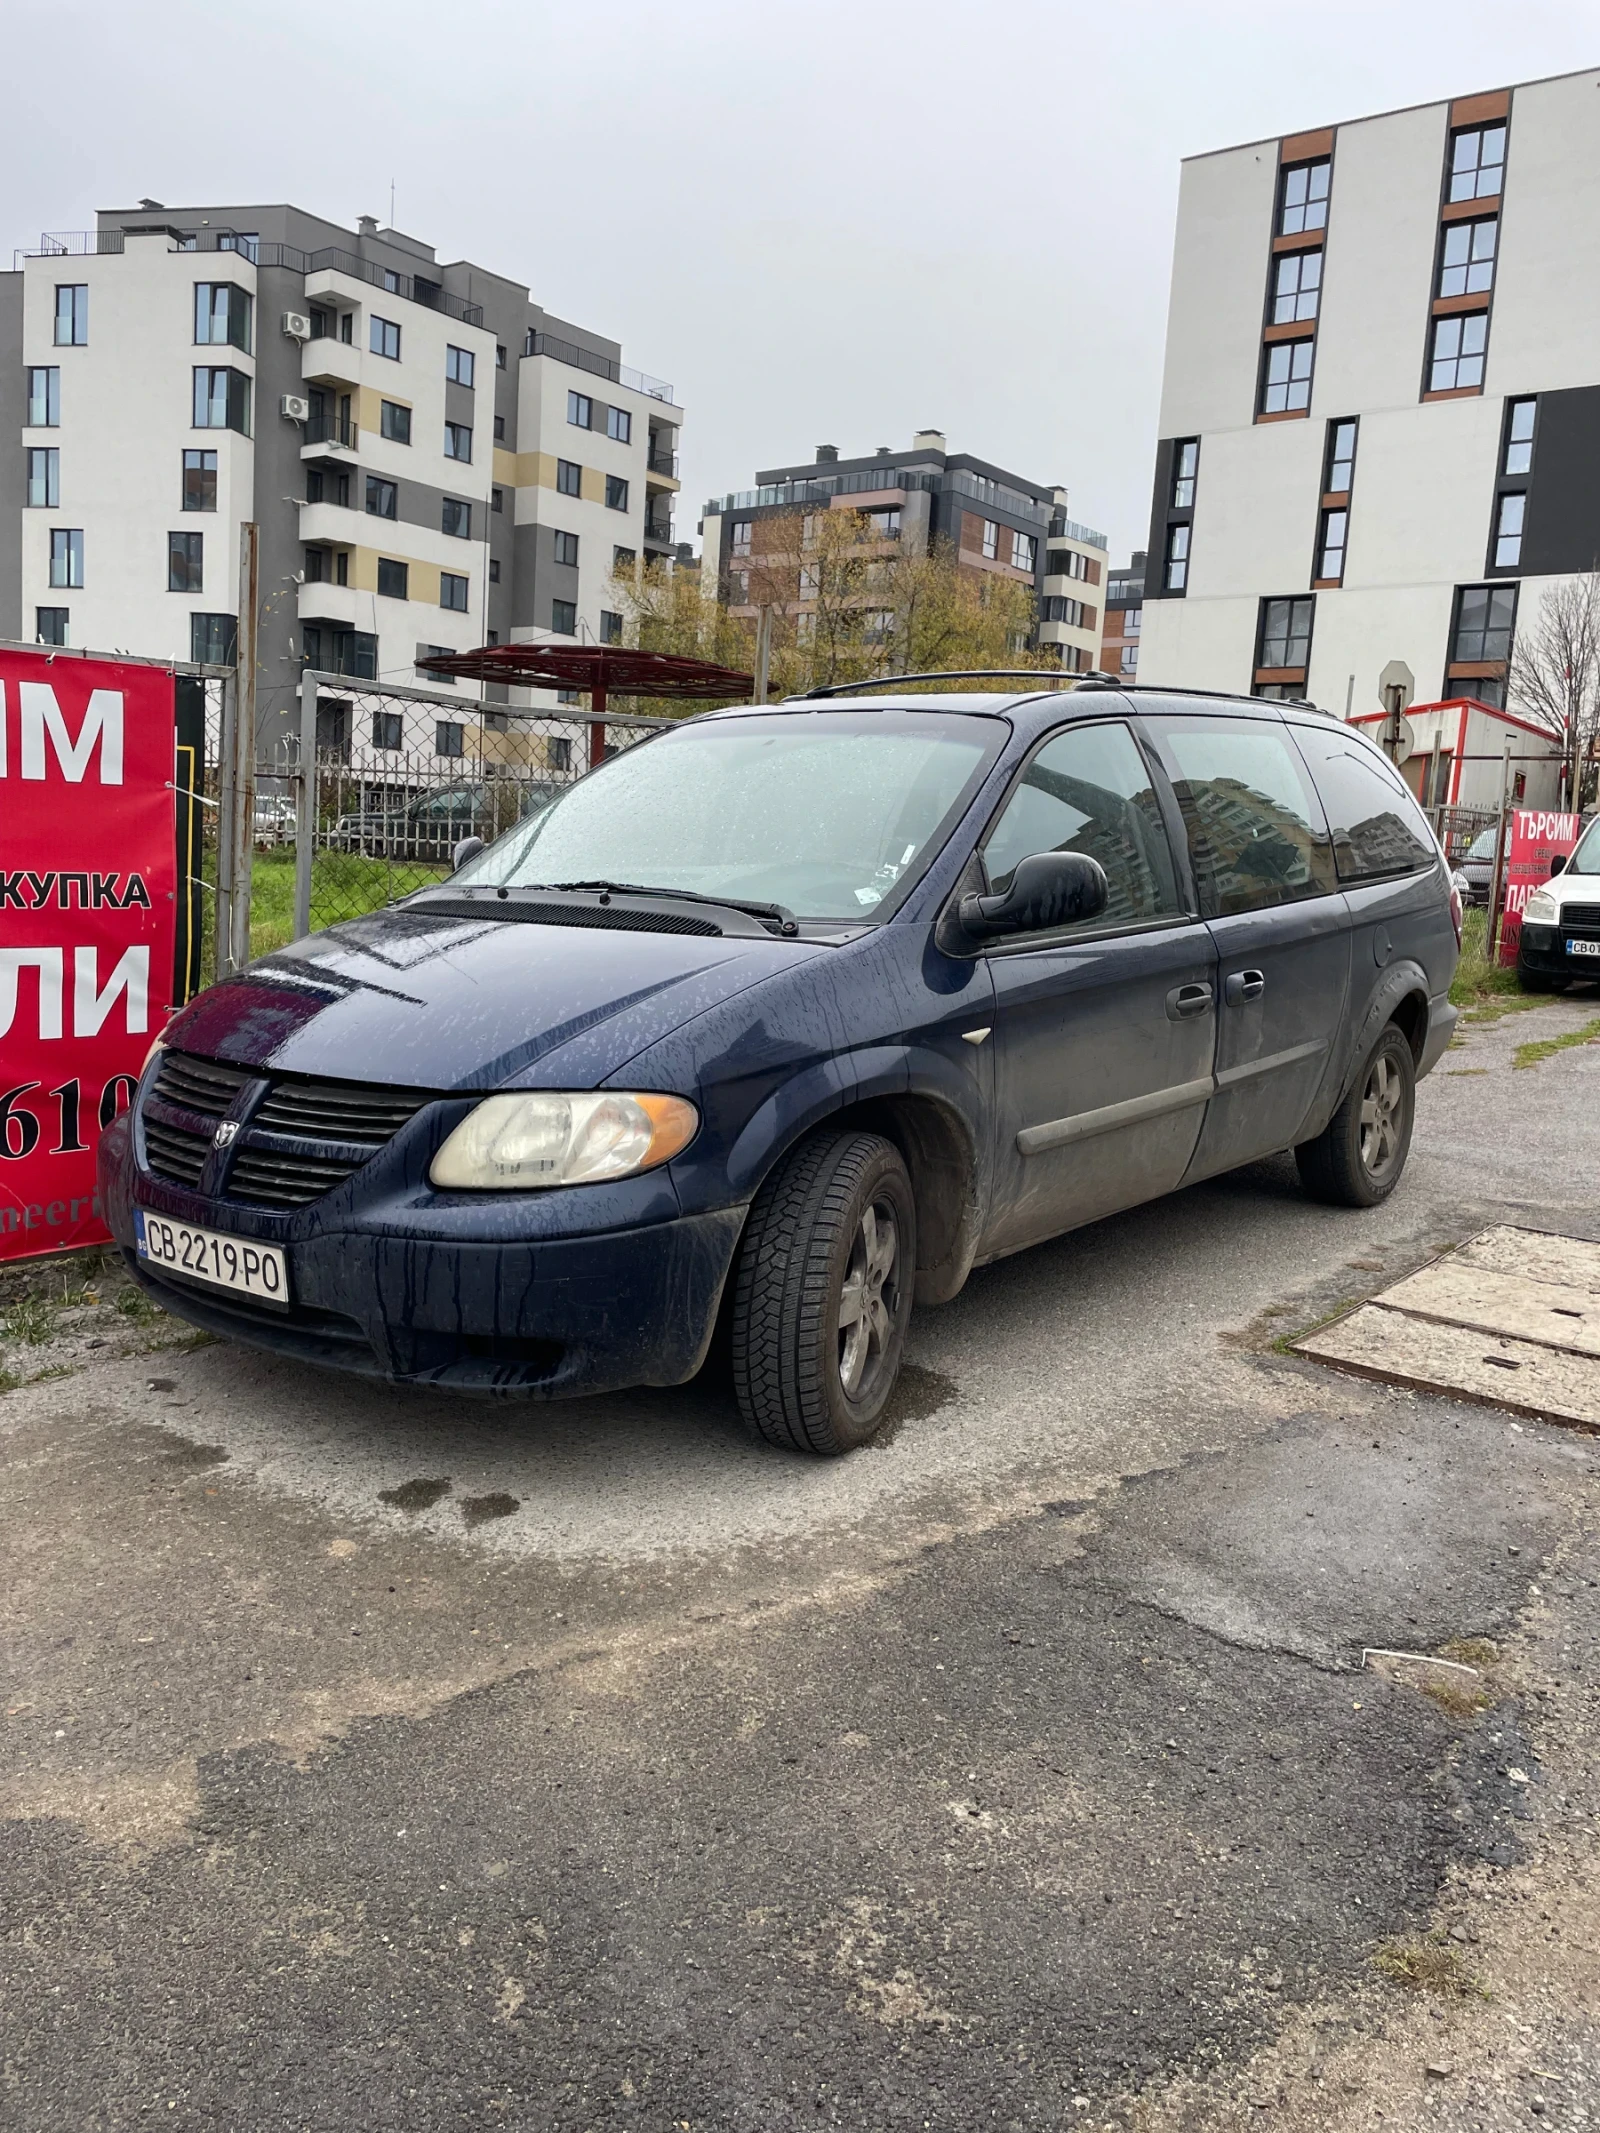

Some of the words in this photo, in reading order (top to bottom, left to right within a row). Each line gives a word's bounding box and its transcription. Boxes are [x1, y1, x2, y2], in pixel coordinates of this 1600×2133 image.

[0, 679, 124, 786] М
[1519, 811, 1574, 841] ТЪРСИМ
[0, 871, 152, 909] КУПКА
[1506, 884, 1541, 913] ПАР
